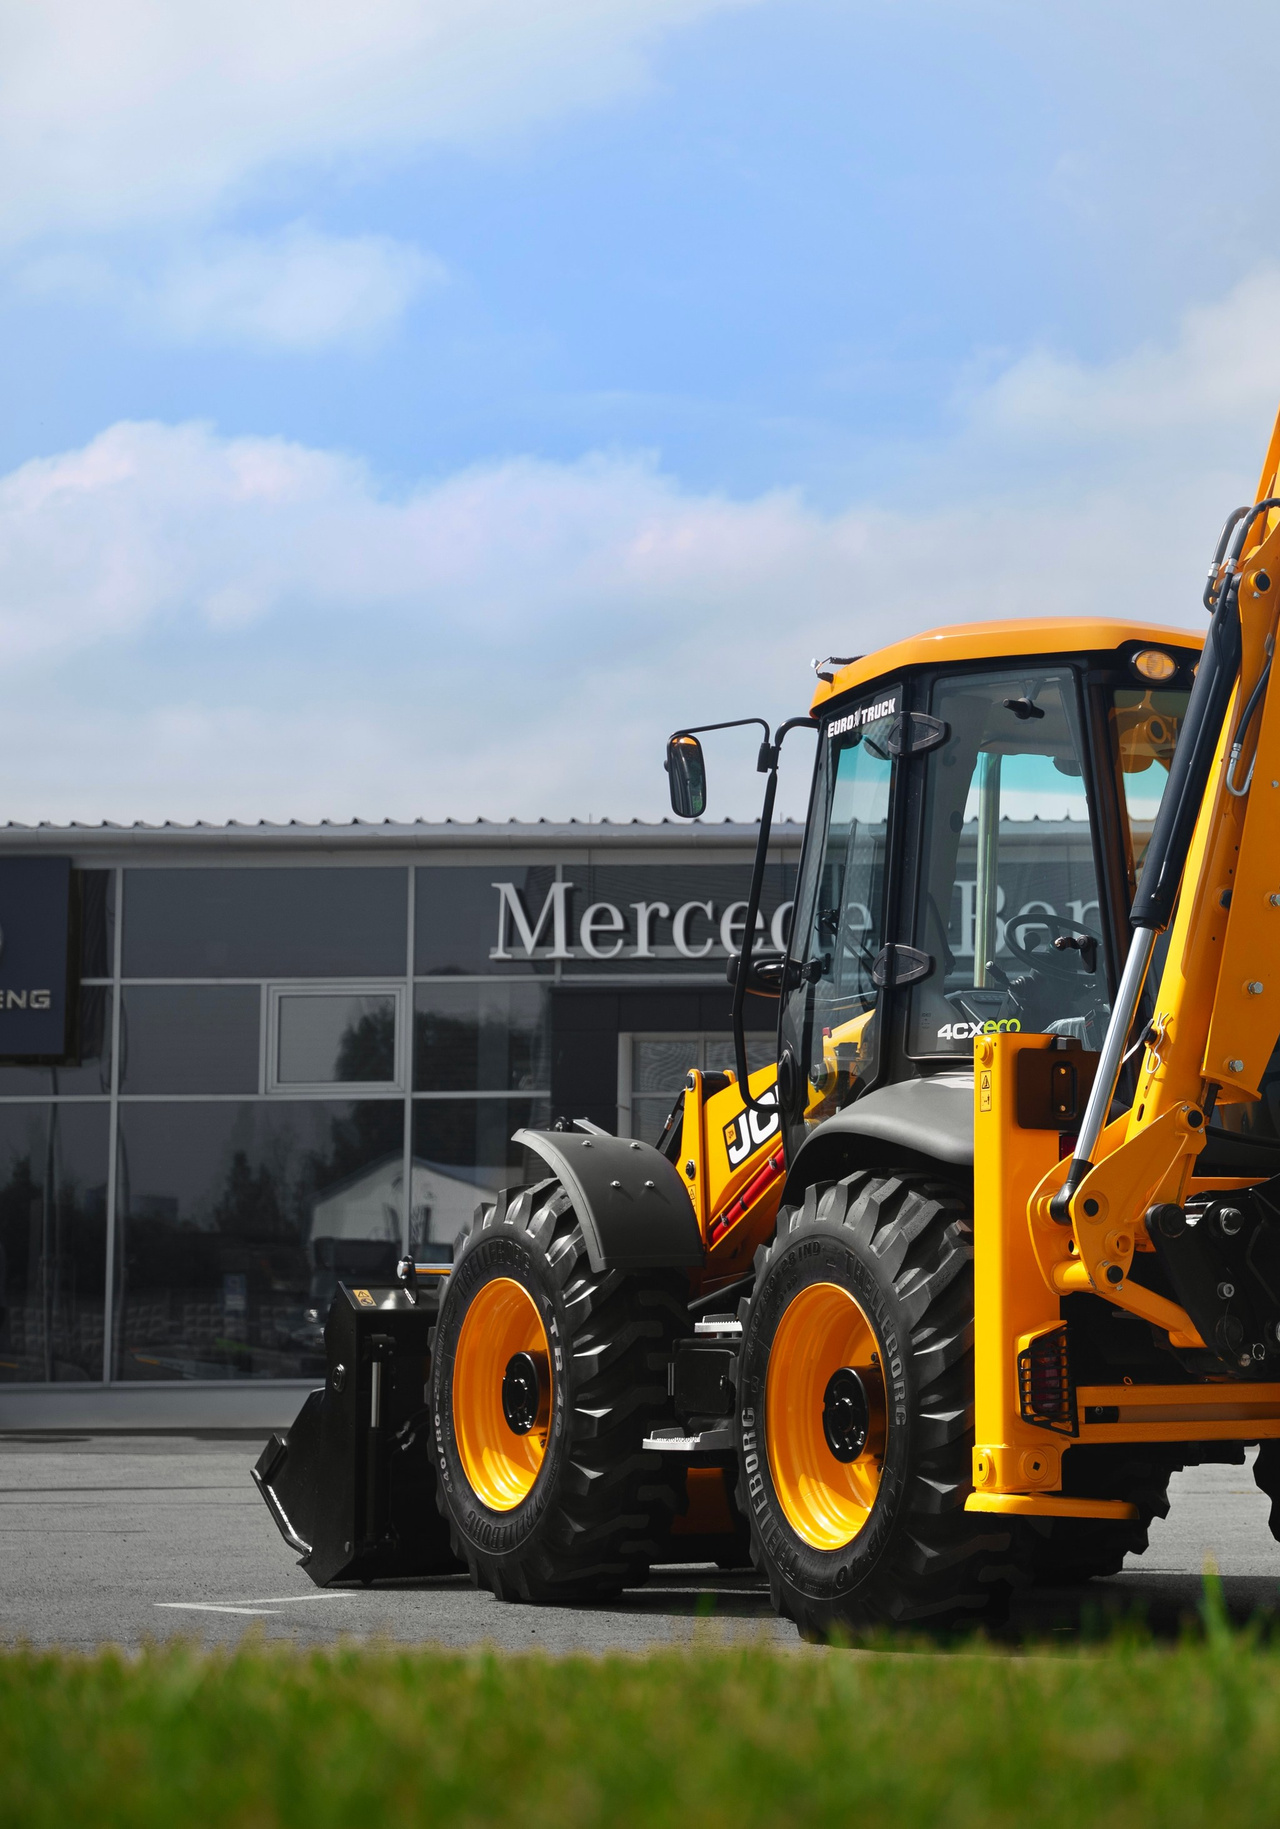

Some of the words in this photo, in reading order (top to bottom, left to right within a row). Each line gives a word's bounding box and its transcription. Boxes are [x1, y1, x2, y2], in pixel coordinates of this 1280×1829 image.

[827, 714, 854, 738] EURO
[861, 697, 896, 725] TRUCK
[728, 1085, 779, 1164] JC
[798, 1240, 821, 1261] IND
[844, 1247, 907, 1427] TRELLEBORG
[741, 1407, 799, 1582] TRELLEBORG
